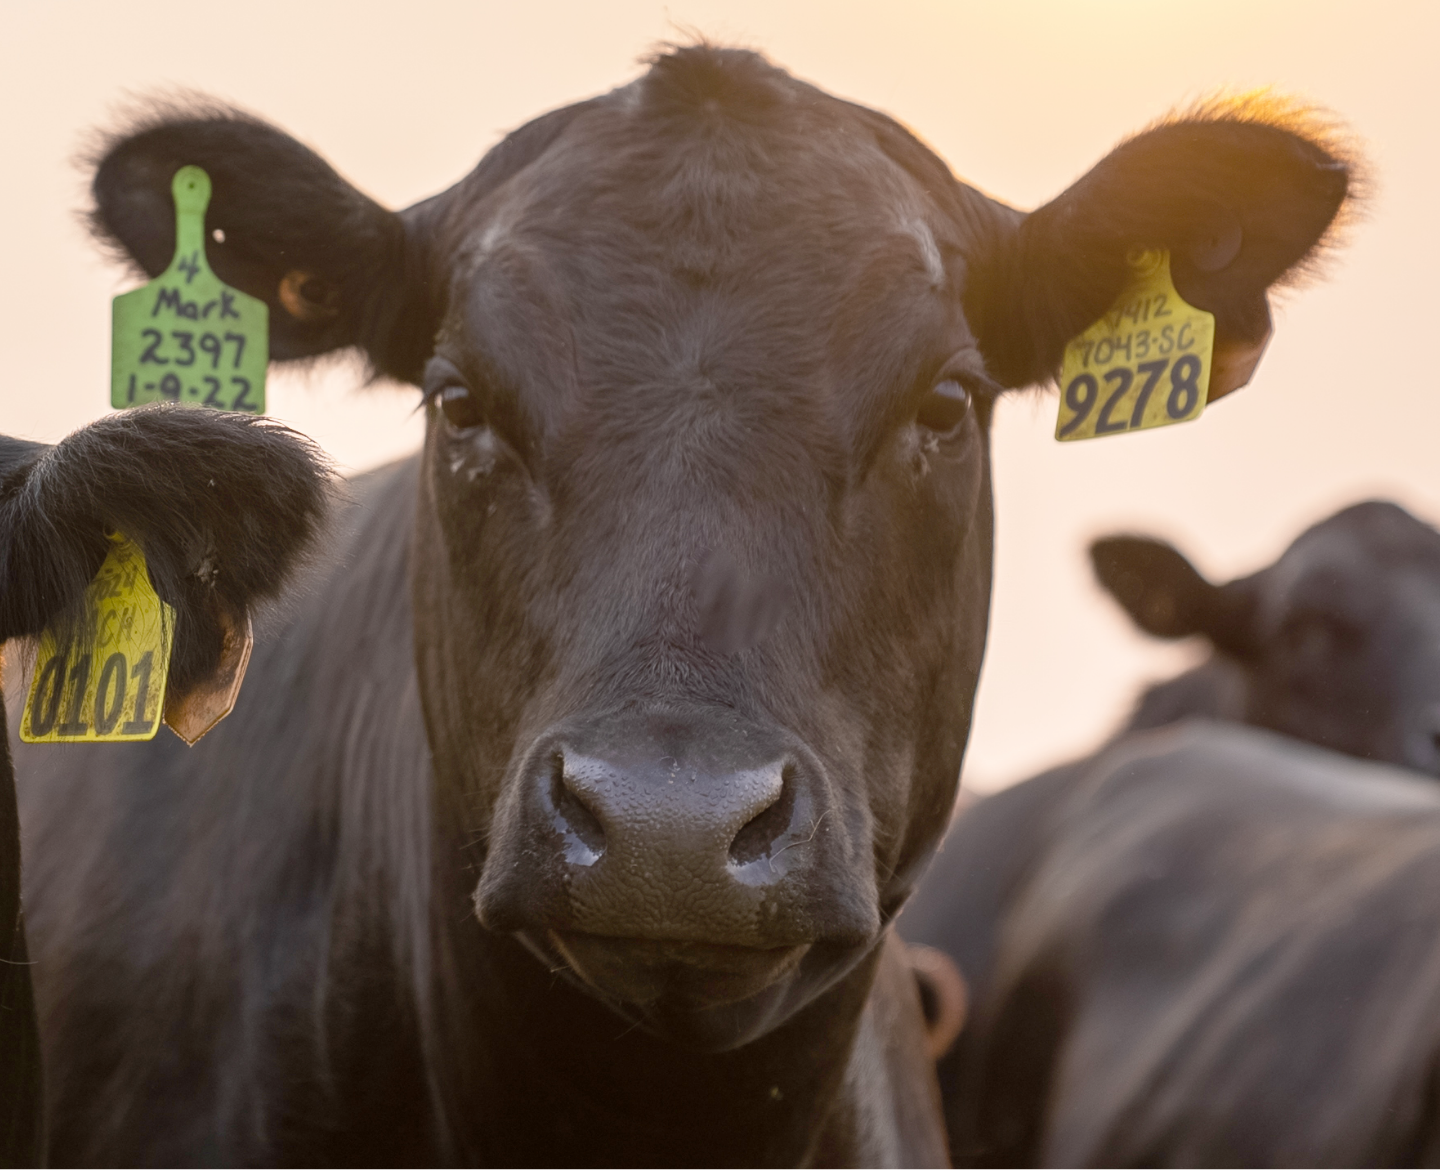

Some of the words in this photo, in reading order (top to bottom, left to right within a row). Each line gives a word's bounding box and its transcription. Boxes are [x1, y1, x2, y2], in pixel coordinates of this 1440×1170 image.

[151, 287, 240, 320] Mark
[139, 328, 246, 369] 2397
[1059, 354, 1202, 439] 9278
[30, 651, 155, 737] 0101
